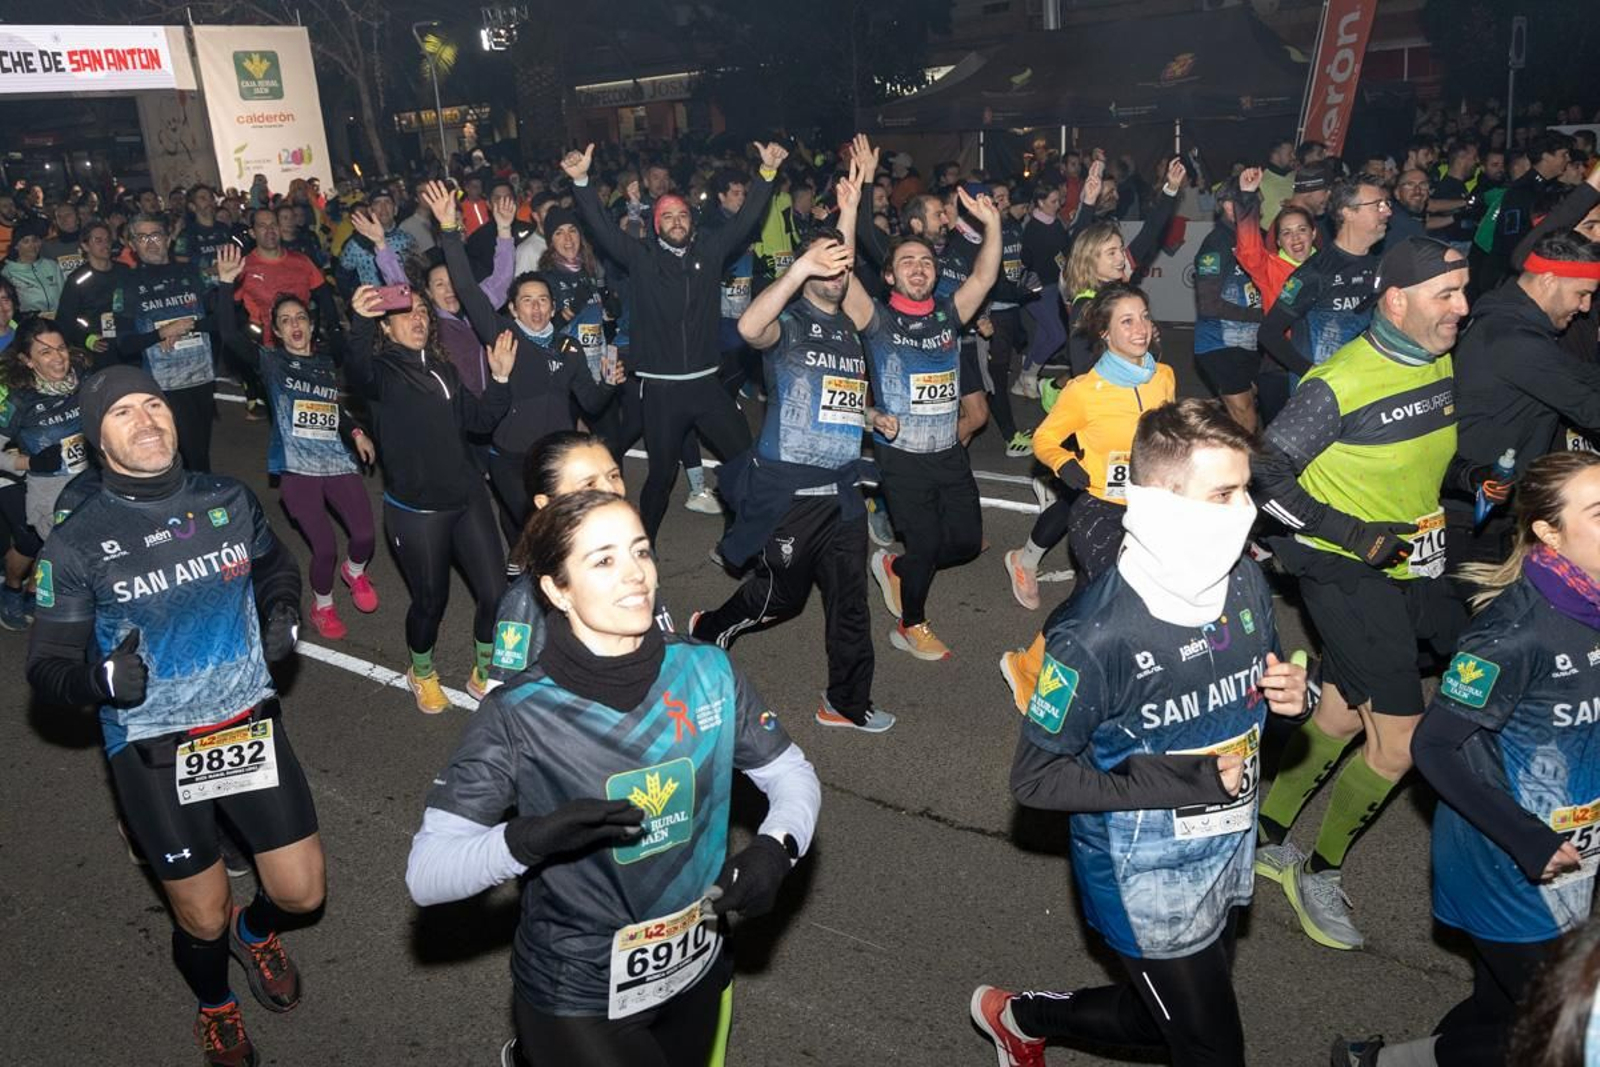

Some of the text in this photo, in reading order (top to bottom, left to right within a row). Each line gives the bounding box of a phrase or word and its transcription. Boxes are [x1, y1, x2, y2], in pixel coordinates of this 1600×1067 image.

[0, 51, 37, 73] CHE
[38, 49, 66, 73] DE
[67, 49, 105, 73] SAN
[141, 298, 164, 312] SAN
[1332, 296, 1360, 311] SAN
[805, 350, 837, 369] SAN
[285, 377, 311, 393] SAN
[915, 383, 955, 399] 7023
[827, 389, 864, 409] 7284
[298, 412, 336, 426] 8836
[113, 541, 249, 603] SAN ANTÓN
[1141, 691, 1200, 730] SAN
[185, 740, 266, 775] 9832
[650, 811, 688, 832] RURAL
[627, 919, 707, 978] 6910
